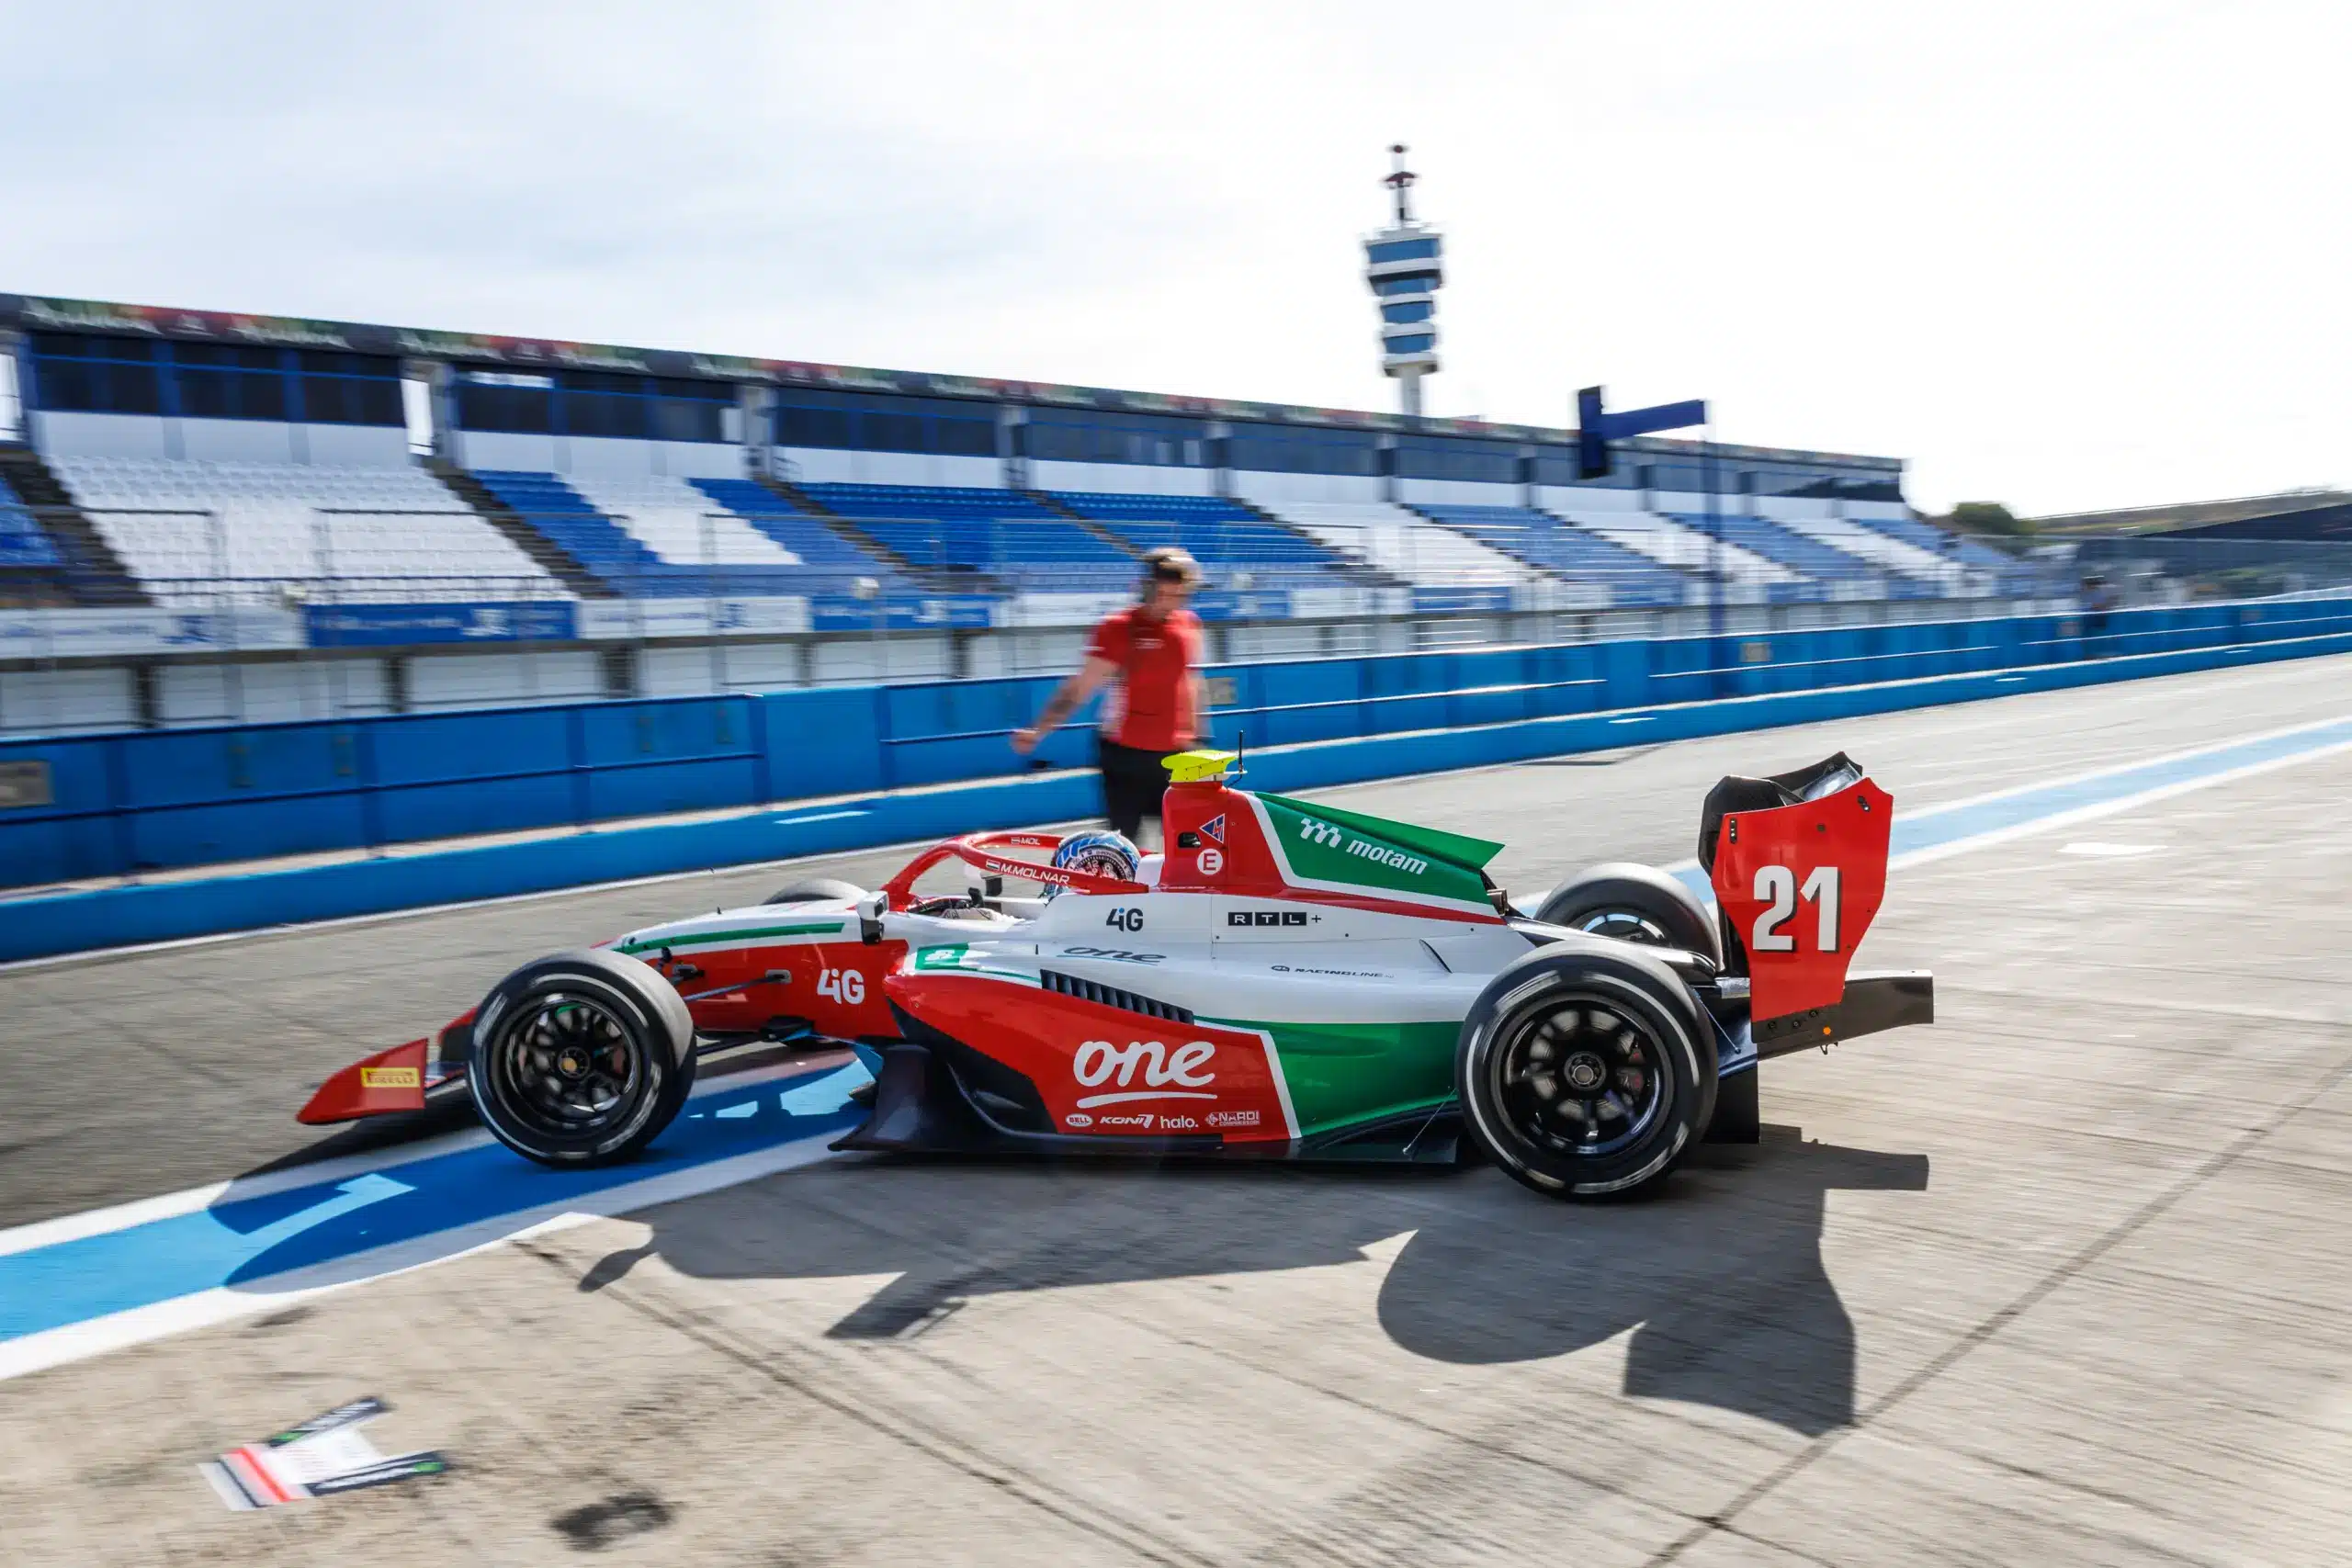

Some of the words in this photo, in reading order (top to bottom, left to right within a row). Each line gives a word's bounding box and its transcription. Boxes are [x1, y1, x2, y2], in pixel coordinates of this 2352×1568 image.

[1020, 838, 1041, 846] MOL
[1203, 852, 1217, 871] E
[1346, 839, 1428, 875] motam
[1000, 863, 1070, 885] M.MOLNAR
[1752, 864, 1841, 953] 21
[1063, 946, 1167, 963] one
[1073, 1041, 1216, 1087] one
